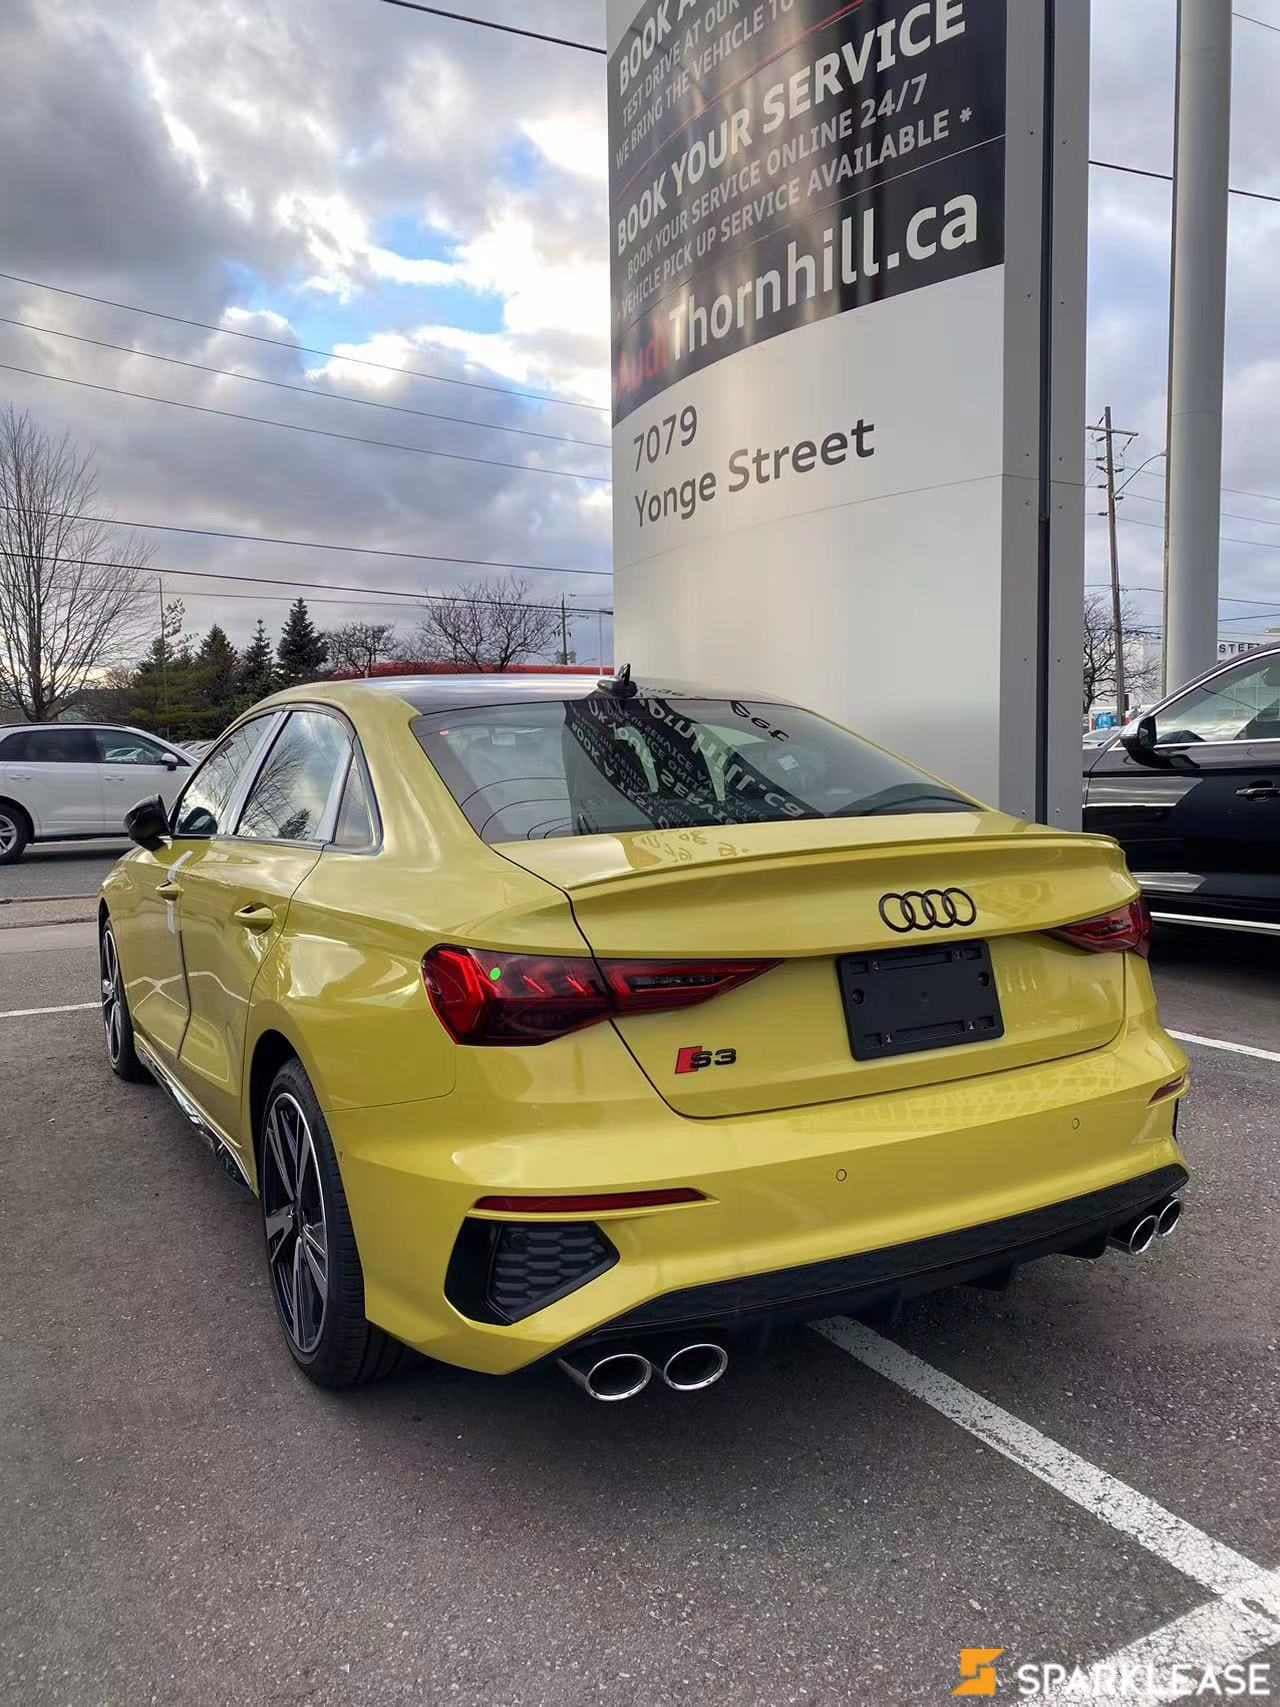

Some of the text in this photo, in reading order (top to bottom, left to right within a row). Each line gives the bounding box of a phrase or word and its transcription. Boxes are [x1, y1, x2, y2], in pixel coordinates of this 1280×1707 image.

[616, 138, 630, 170] WE
[631, 96, 663, 151] BRING
[665, 68, 690, 109] THE
[692, 5, 764, 81] VEHICLE
[620, 0, 672, 96] BOOK
[623, 86, 643, 128] TEST
[645, 40, 681, 97] DRIVE
[684, 18, 701, 54] AT
[618, 0, 966, 256] BOOK YOUR SERVICE
[628, 73, 928, 281] BOOK YOUR SERVICE ONLINE 24/7
[622, 266, 661, 319] VEHICLE
[663, 241, 693, 281] PICK
[696, 226, 717, 257] UP
[720, 178, 800, 243] SERVICE
[807, 108, 950, 197] AVAILABLE
[633, 404, 698, 472] 7079
[635, 419, 875, 527] Yonge Street
[689, 1047, 737, 1069] S3
